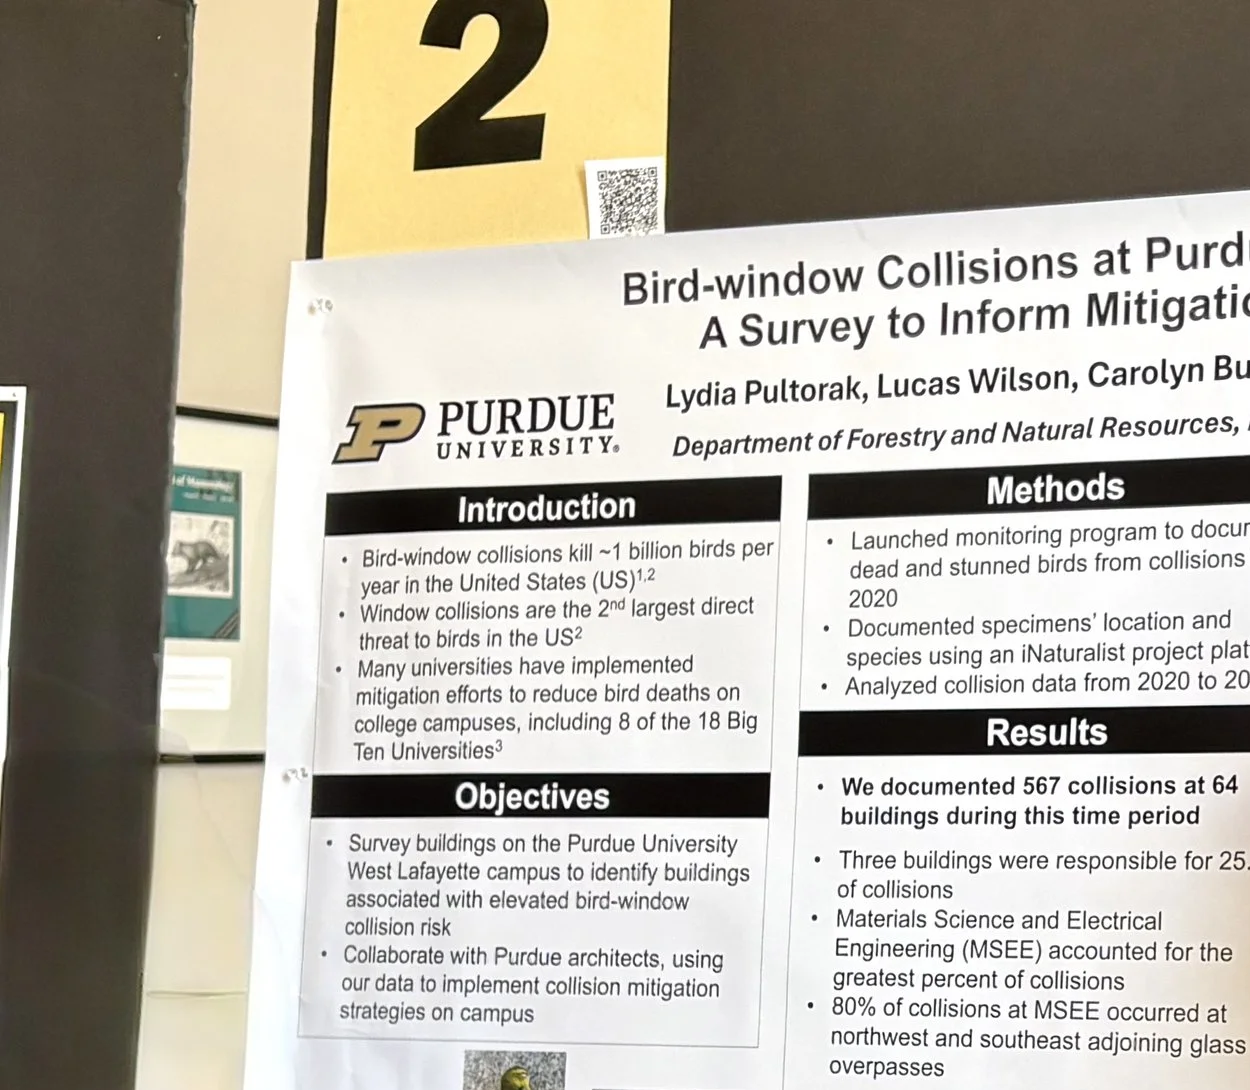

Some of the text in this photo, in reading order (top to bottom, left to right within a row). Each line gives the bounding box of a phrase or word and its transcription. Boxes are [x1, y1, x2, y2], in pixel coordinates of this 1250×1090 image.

[412, 0, 549, 171] 2
[623, 261, 864, 306] Bird-window
[877, 247, 1078, 290] Collisions
[1093, 240, 1131, 276] at
[698, 316, 728, 350] A
[739, 313, 875, 351] Survey
[887, 306, 925, 339] to
[940, 299, 1070, 336] Inform
[666, 381, 736, 414] Lydia
[745, 375, 868, 405] Pultorak,
[877, 373, 960, 399] Lucas
[968, 366, 1078, 394] Wilson,
[1088, 358, 1204, 390] Carolyn
[437, 393, 615, 437] PURDUE
[672, 432, 814, 461] Department
[818, 430, 845, 452] of
[847, 426, 948, 452] Forestry
[950, 421, 998, 446] and
[1002, 417, 1094, 443] Natural
[1099, 415, 1239, 438] Resources,
[988, 472, 1125, 504] Methods
[459, 492, 636, 523] Introduction
[363, 546, 472, 568] Bird-window
[477, 544, 563, 564] collisions
[569, 542, 593, 562] kill
[629, 540, 682, 560] billion
[689, 538, 736, 558] birds
[742, 541, 774, 560] per
[987, 717, 1108, 746] Results
[455, 782, 610, 815] Objectives
[841, 774, 1239, 796] We documented 567 collisions at 64
[349, 833, 738, 858] Survey buildings on the Purdue University
